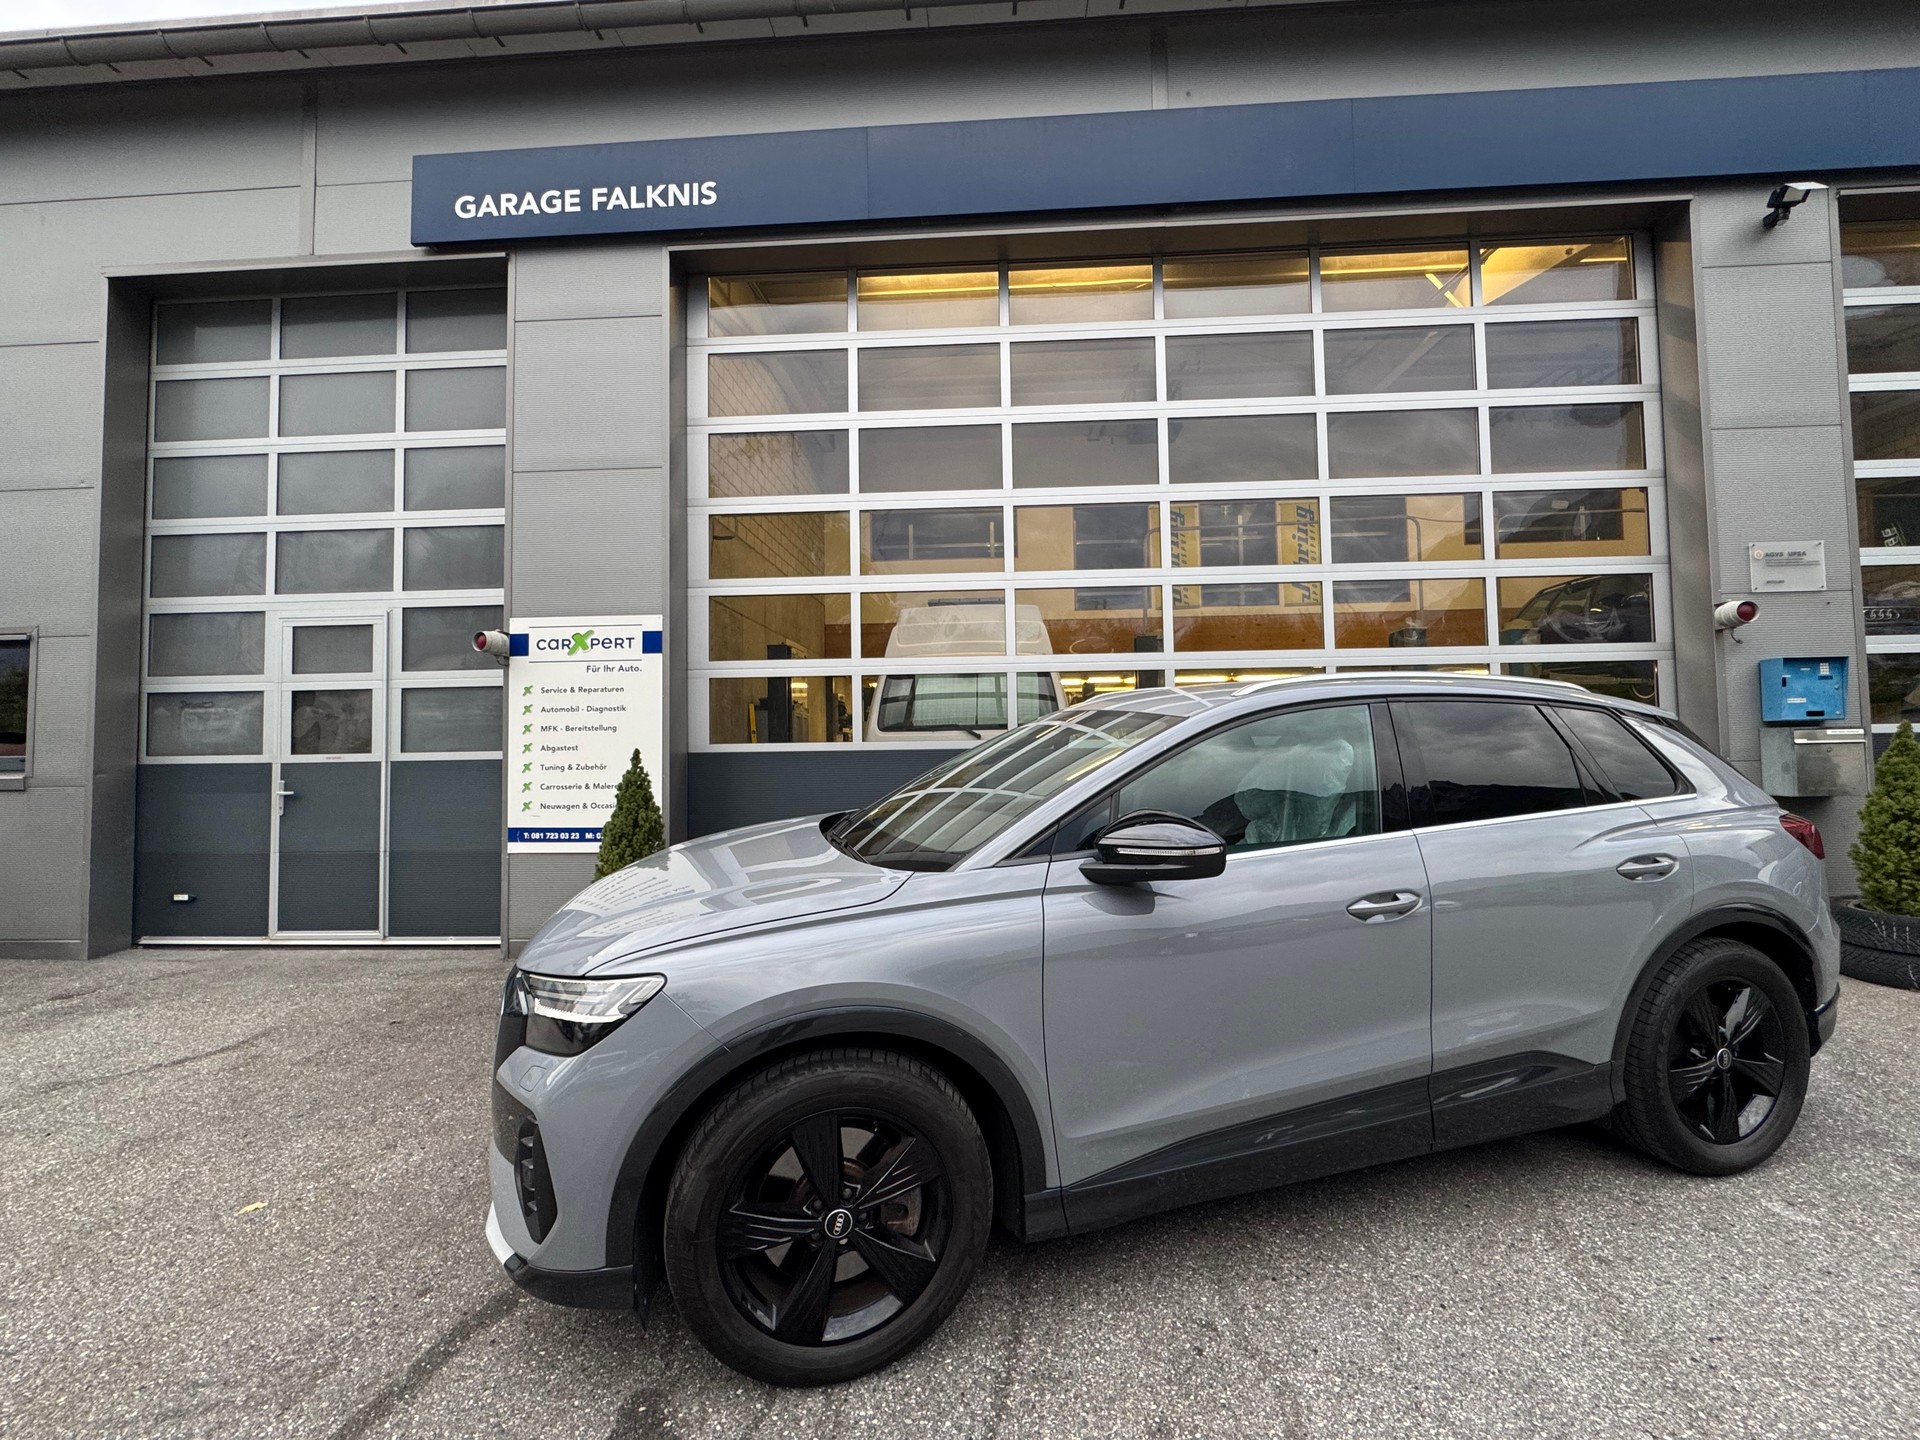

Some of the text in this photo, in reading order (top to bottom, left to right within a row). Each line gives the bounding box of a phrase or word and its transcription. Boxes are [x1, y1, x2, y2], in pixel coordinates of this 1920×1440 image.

[454, 181, 718, 219] GARAGE FALKNIS
[586, 664, 642, 673] Für Ihr Auto.
[540, 686, 568, 694] Service
[578, 686, 624, 694] Reparaturen
[540, 705, 580, 713] Automobil
[586, 704, 626, 713] Diagnostik
[565, 724, 617, 733] Bereitstellung
[540, 744, 579, 752] Abgastest
[540, 764, 565, 772] Tuning
[575, 763, 608, 771] Zubehör
[593, 782, 619, 790] Malere
[540, 802, 580, 810] Neuwagen
